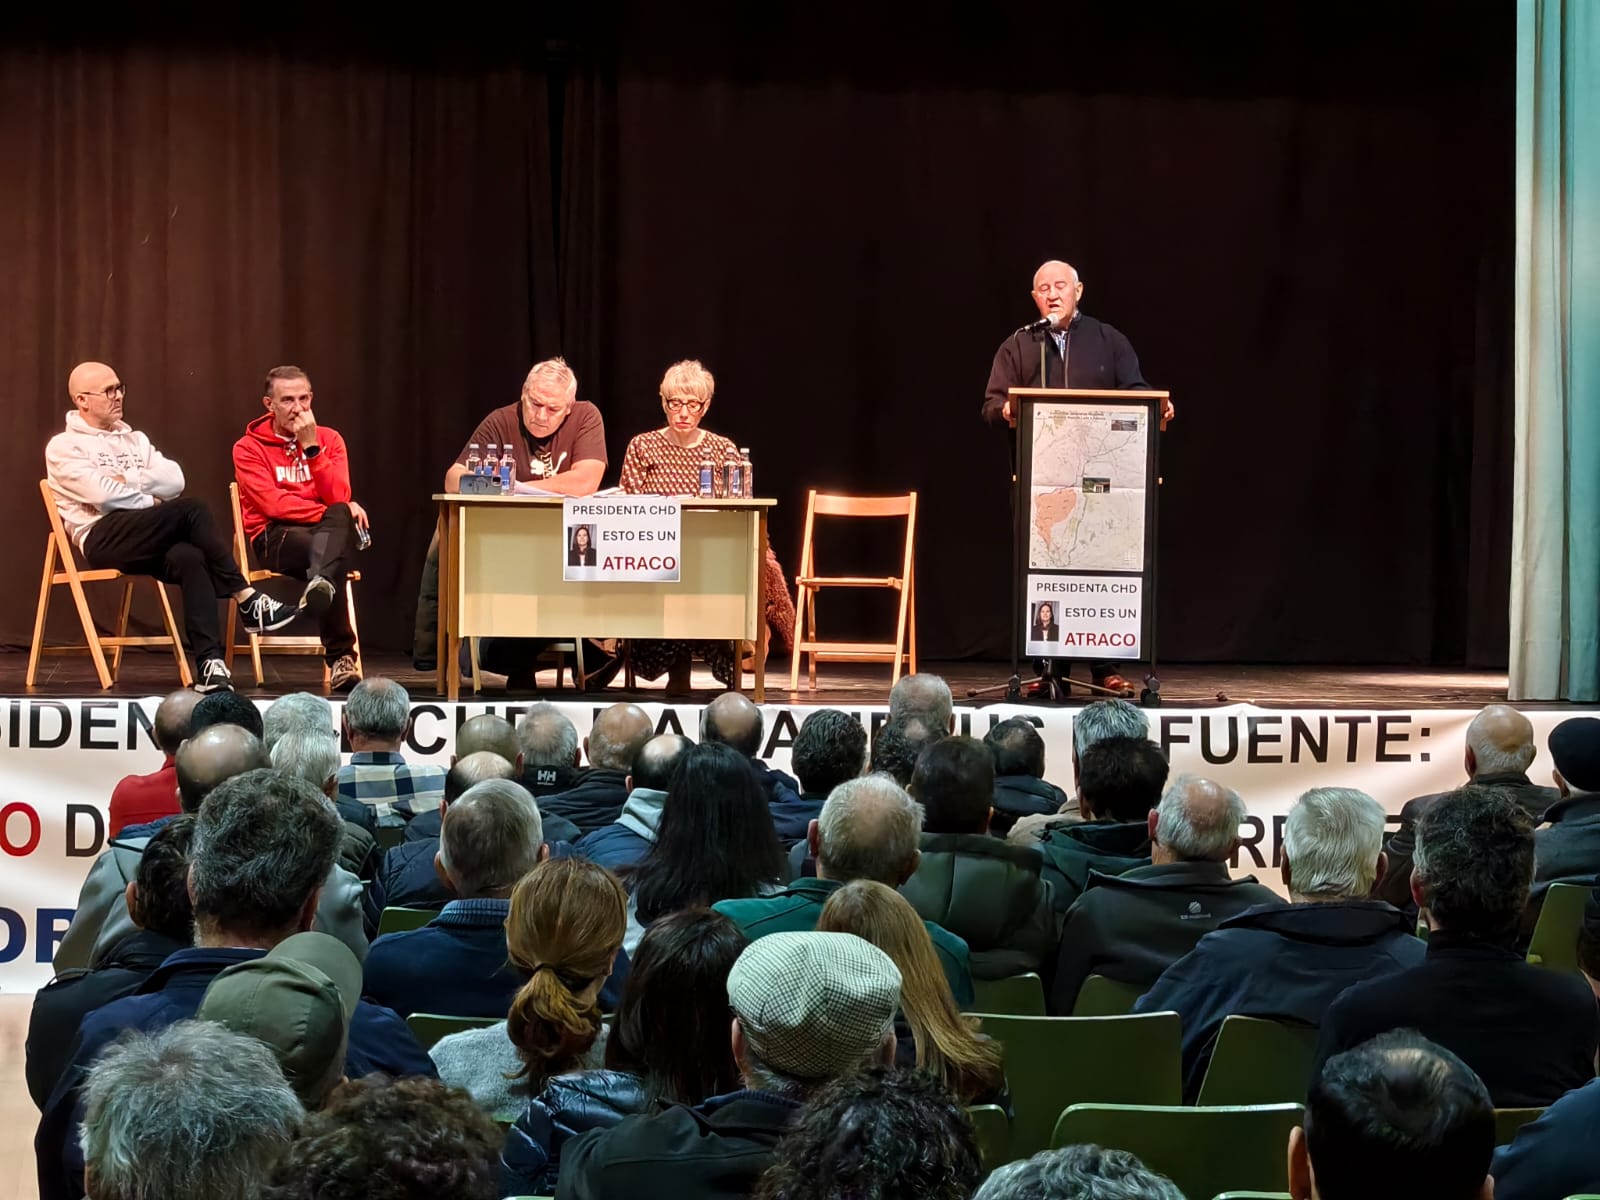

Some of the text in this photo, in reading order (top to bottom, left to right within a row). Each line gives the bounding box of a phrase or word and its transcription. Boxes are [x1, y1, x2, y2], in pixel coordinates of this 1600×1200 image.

[275, 464, 313, 482] PUM
[572, 505, 677, 515] PRESIDENTA CHD
[602, 530, 676, 541] ESTO ES UN
[602, 556, 677, 571] ATRACO
[1036, 582, 1137, 594] PRESIDENTA CHD
[1065, 607, 1137, 619] ESTO ES UN
[1064, 632, 1136, 647] ATRACO
[0, 700, 162, 750] IDEN
[1073, 715, 1431, 765] FUENTE:
[66, 804, 105, 857] D
